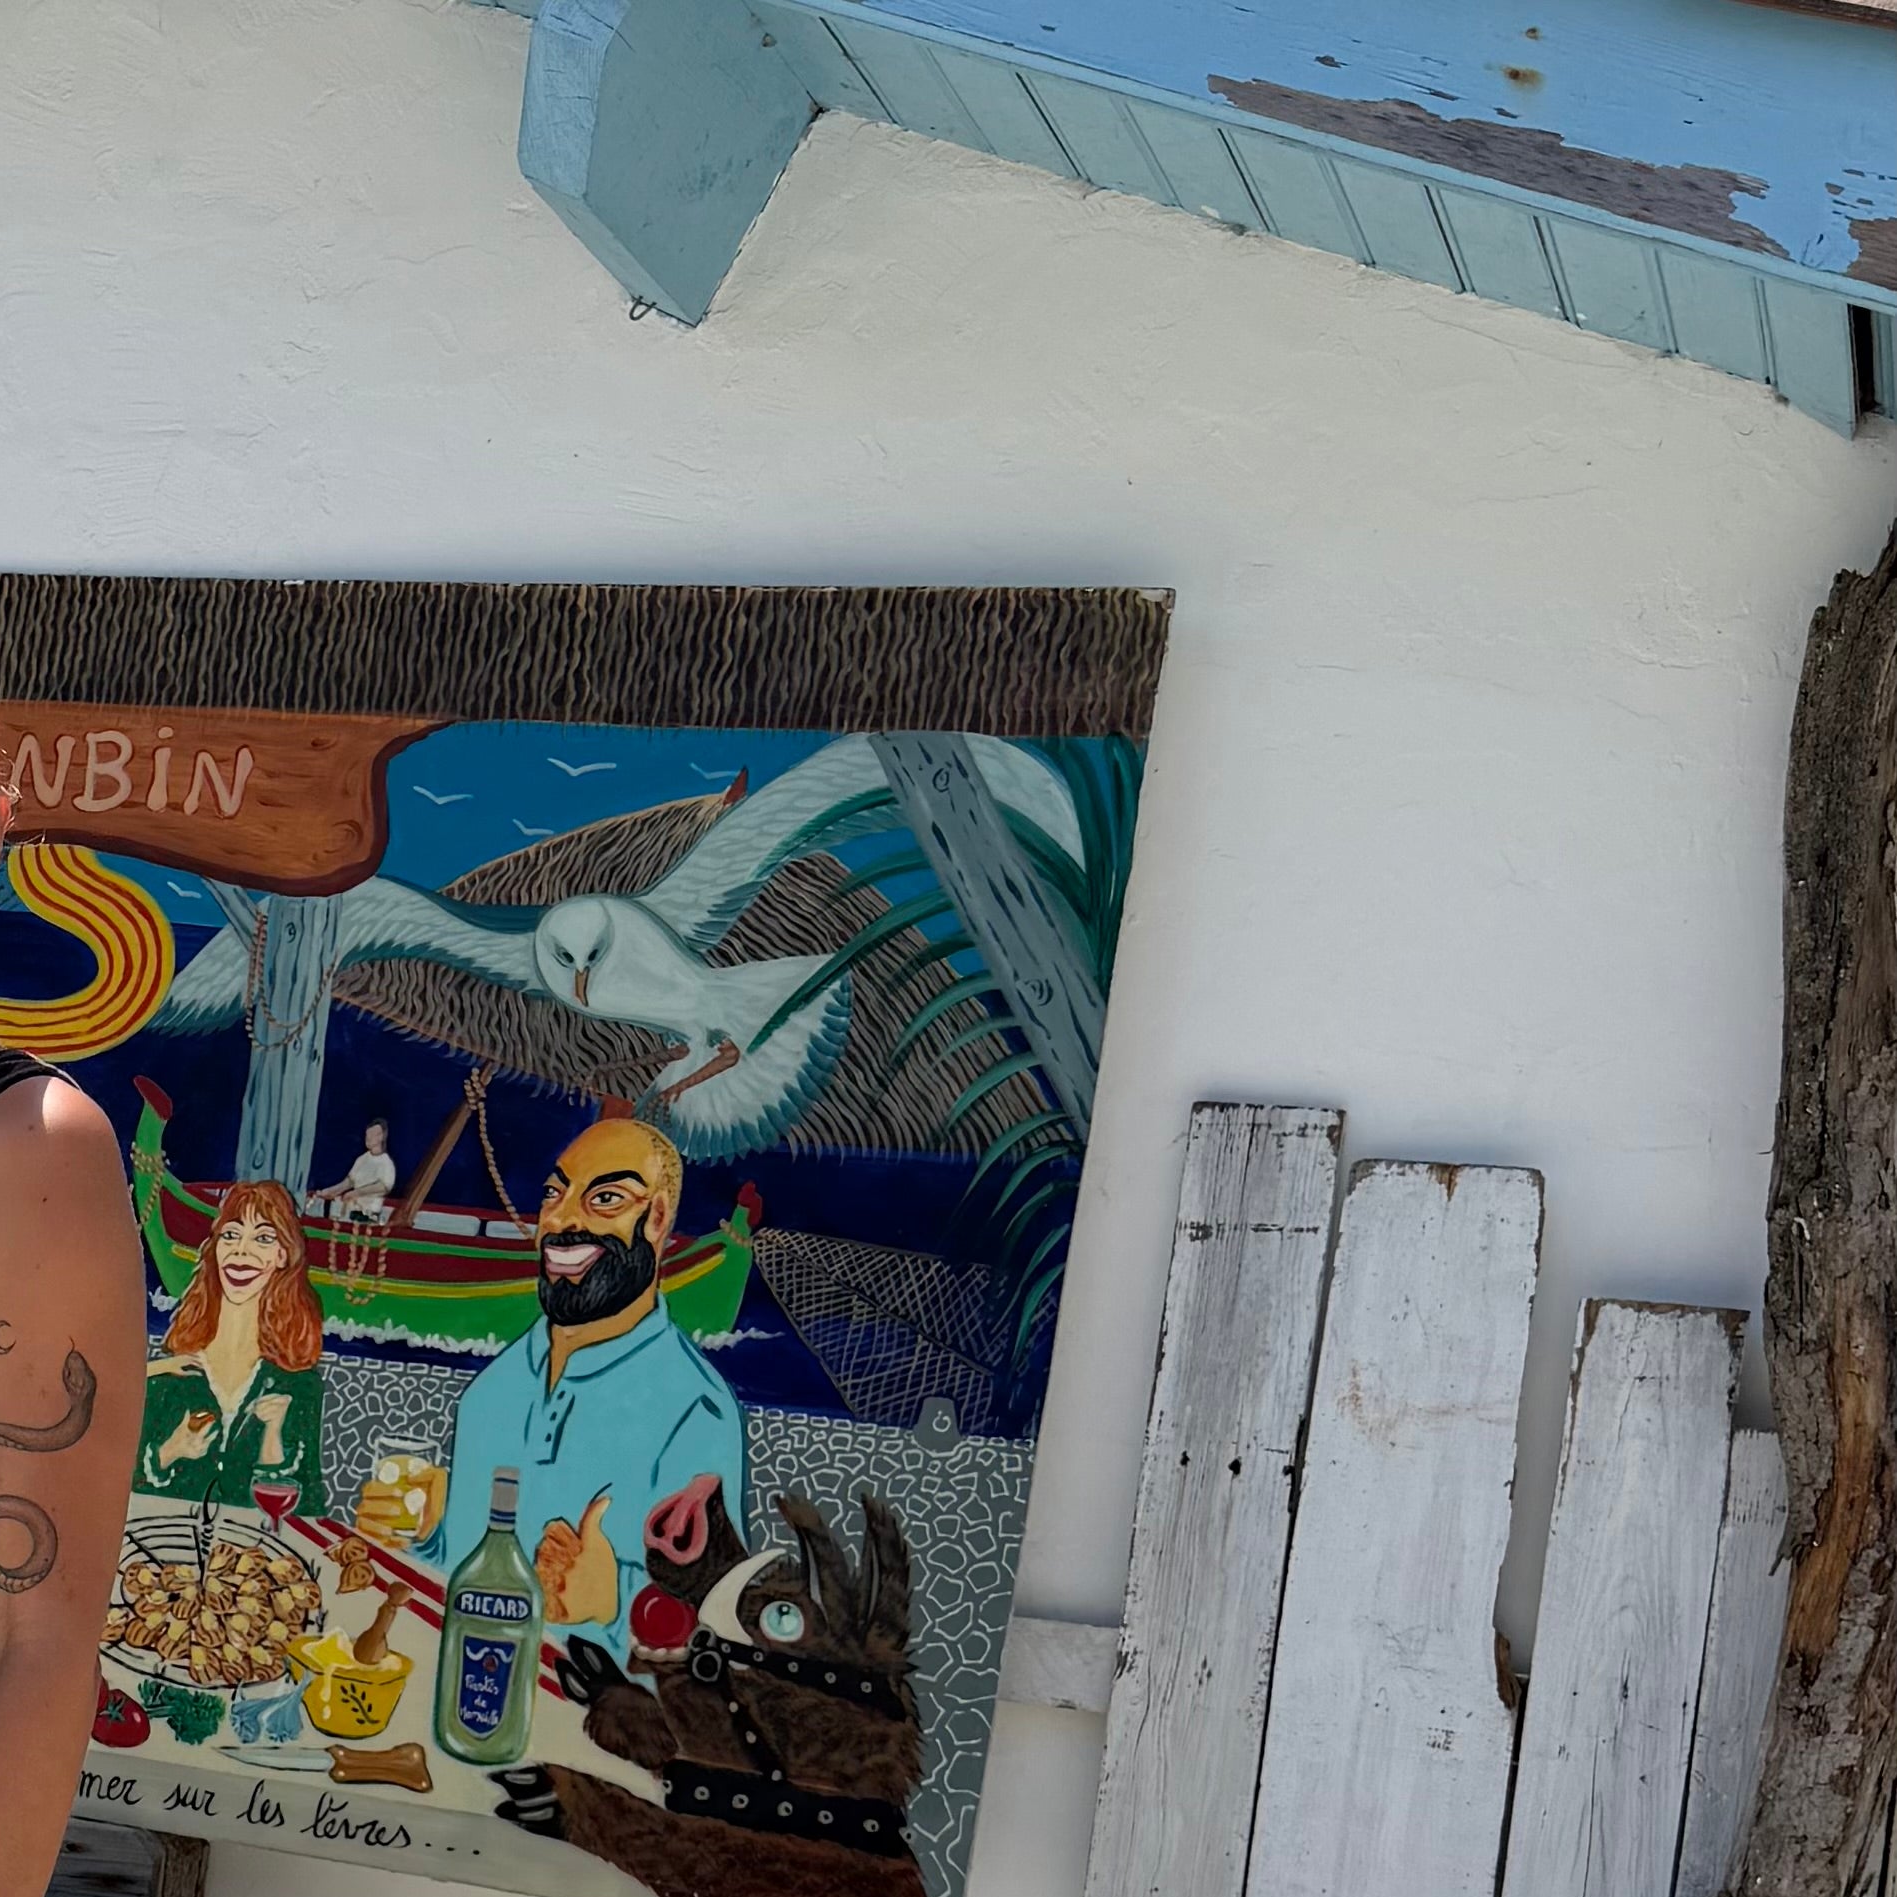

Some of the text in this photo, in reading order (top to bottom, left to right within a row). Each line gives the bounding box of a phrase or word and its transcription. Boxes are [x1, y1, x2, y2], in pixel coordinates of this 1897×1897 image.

[9, 726, 254, 818] NBIN
[460, 1593, 529, 1618] RICARD
[474, 1694, 487, 1708] de
[78, 1769, 144, 1806] mer
[162, 1781, 217, 1817] sur
[236, 1778, 286, 1828] les
